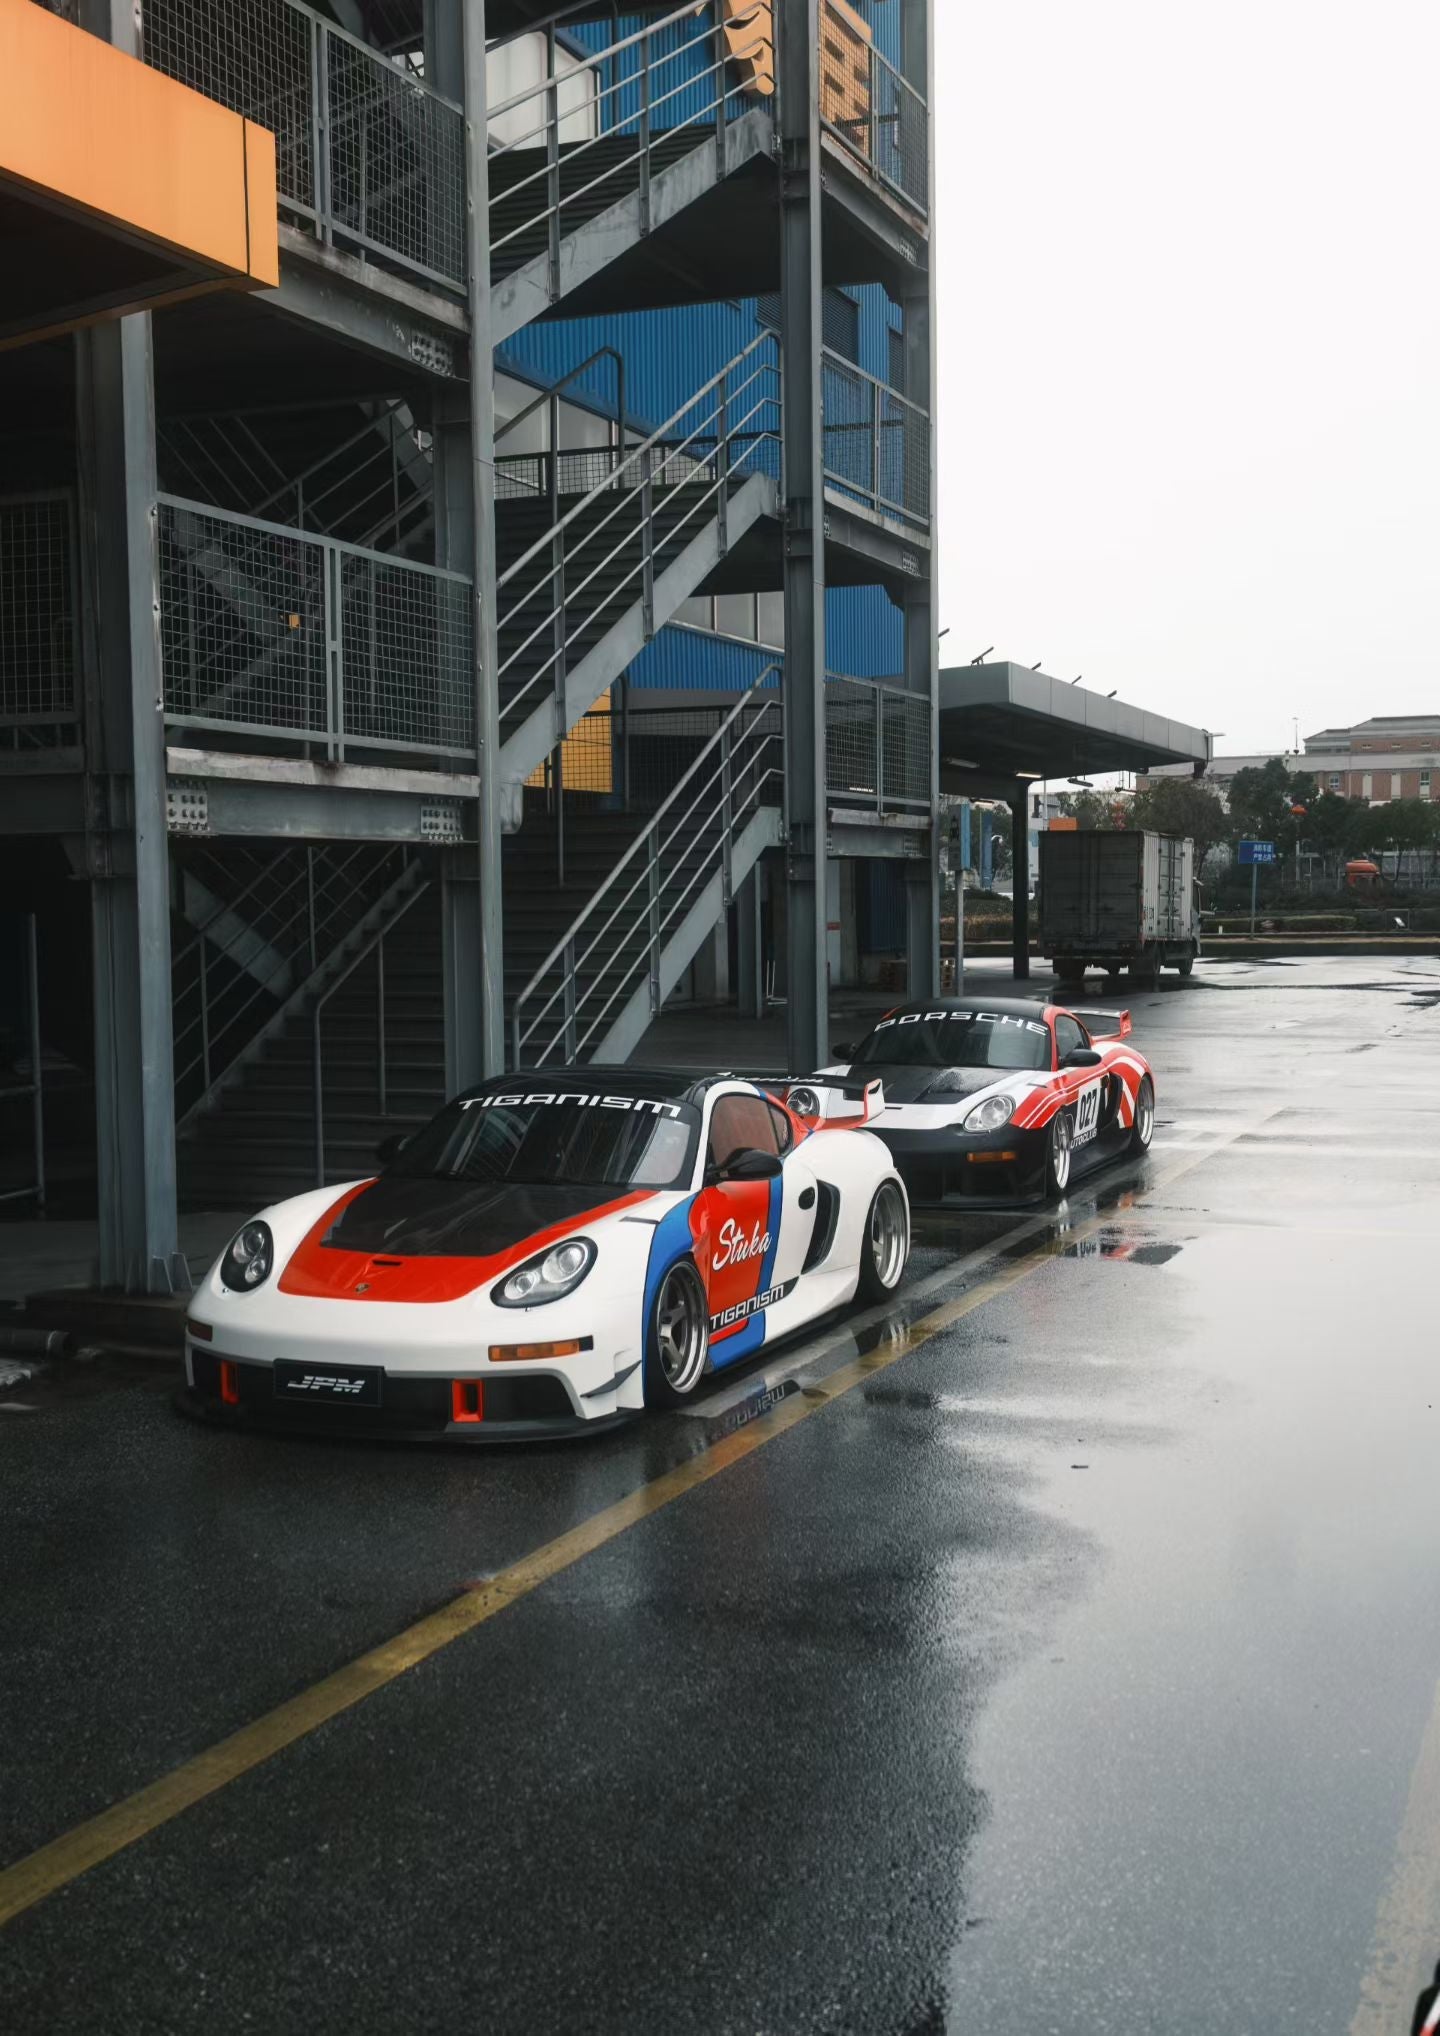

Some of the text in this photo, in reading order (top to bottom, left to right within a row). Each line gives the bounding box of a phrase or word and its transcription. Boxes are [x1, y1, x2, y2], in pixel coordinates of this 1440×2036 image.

[874, 1011, 1049, 1036] PORSCHE
[459, 1093, 682, 1118] TIGANISM
[1078, 1087, 1098, 1131] 027
[1069, 1127, 1098, 1149] UTOCLUB
[712, 1217, 772, 1271] Stuka
[709, 1283, 785, 1329] TIGANISM
[287, 1375, 366, 1394] JPM
